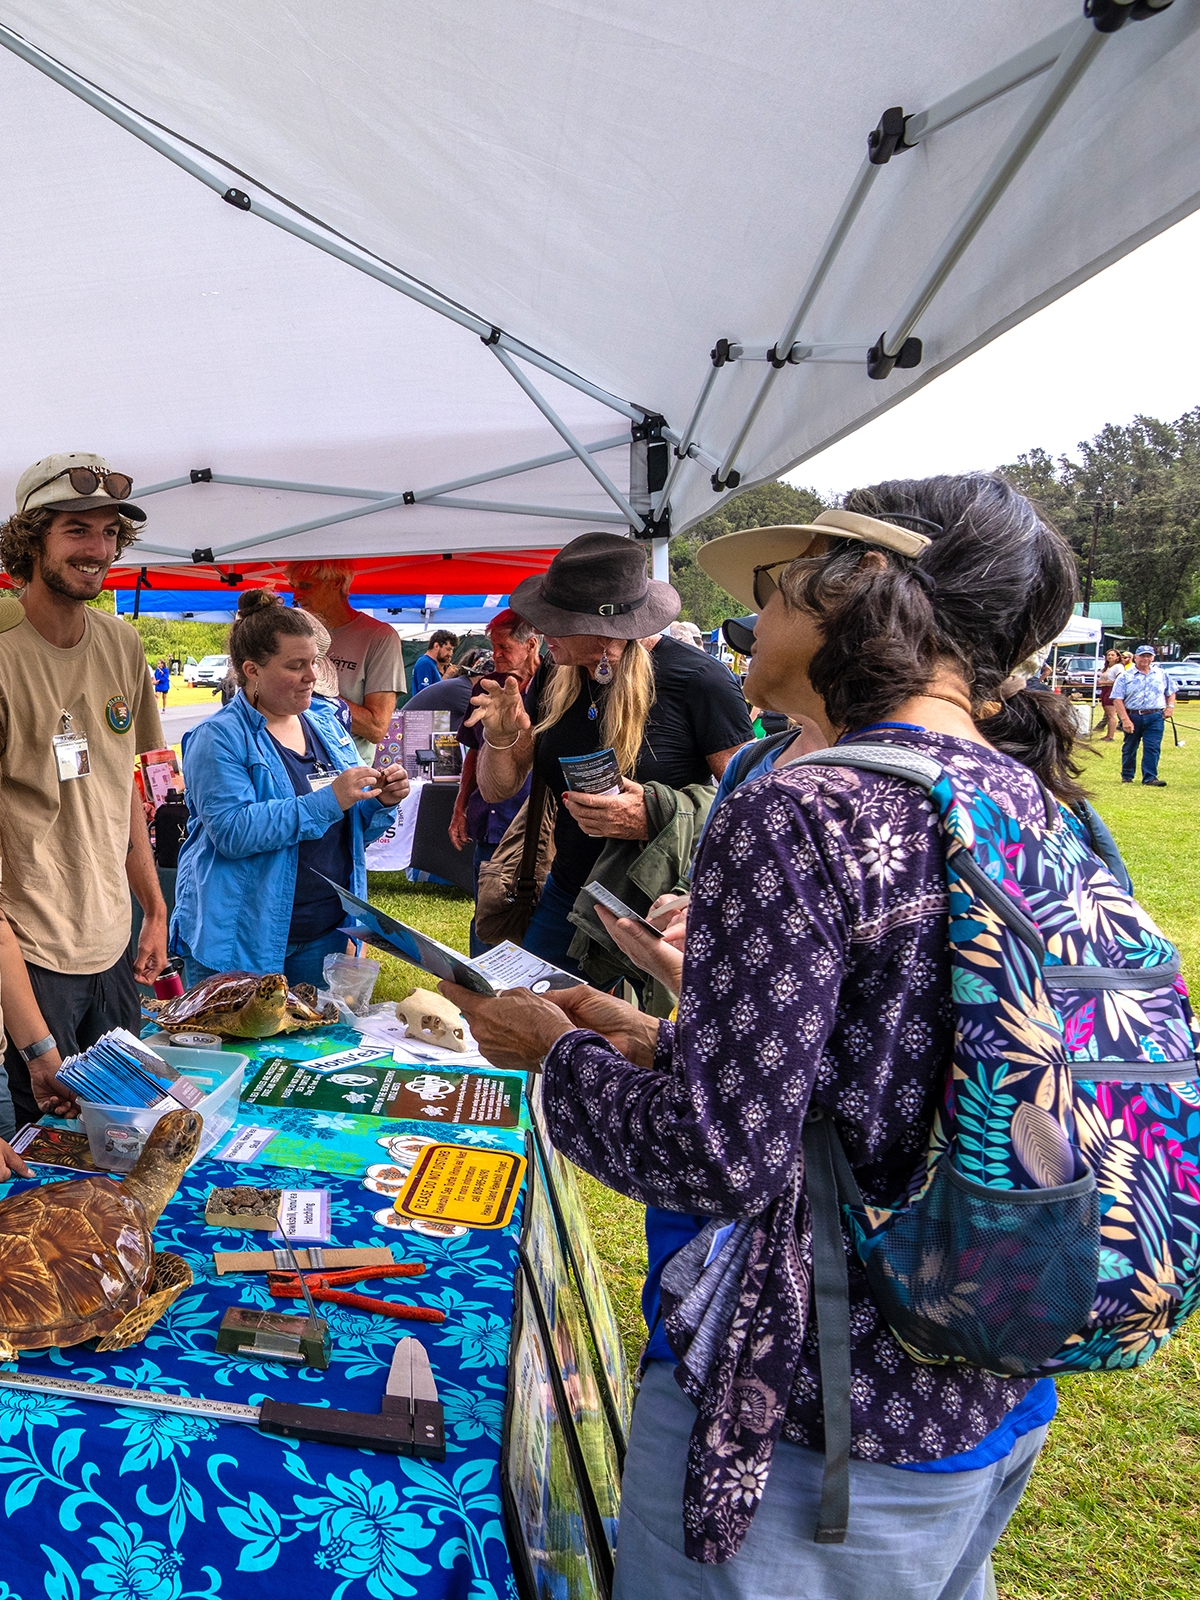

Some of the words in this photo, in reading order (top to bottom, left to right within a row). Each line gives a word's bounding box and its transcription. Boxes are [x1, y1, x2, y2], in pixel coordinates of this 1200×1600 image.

[431, 1150, 450, 1169] DISTURB
[422, 1180, 437, 1188] DO
[426, 1169, 442, 1180] NOT
[413, 1189, 434, 1209] PLEASE
[286, 1211, 298, 1235] Hawksbill,
[303, 1203, 315, 1224] Hatchling
